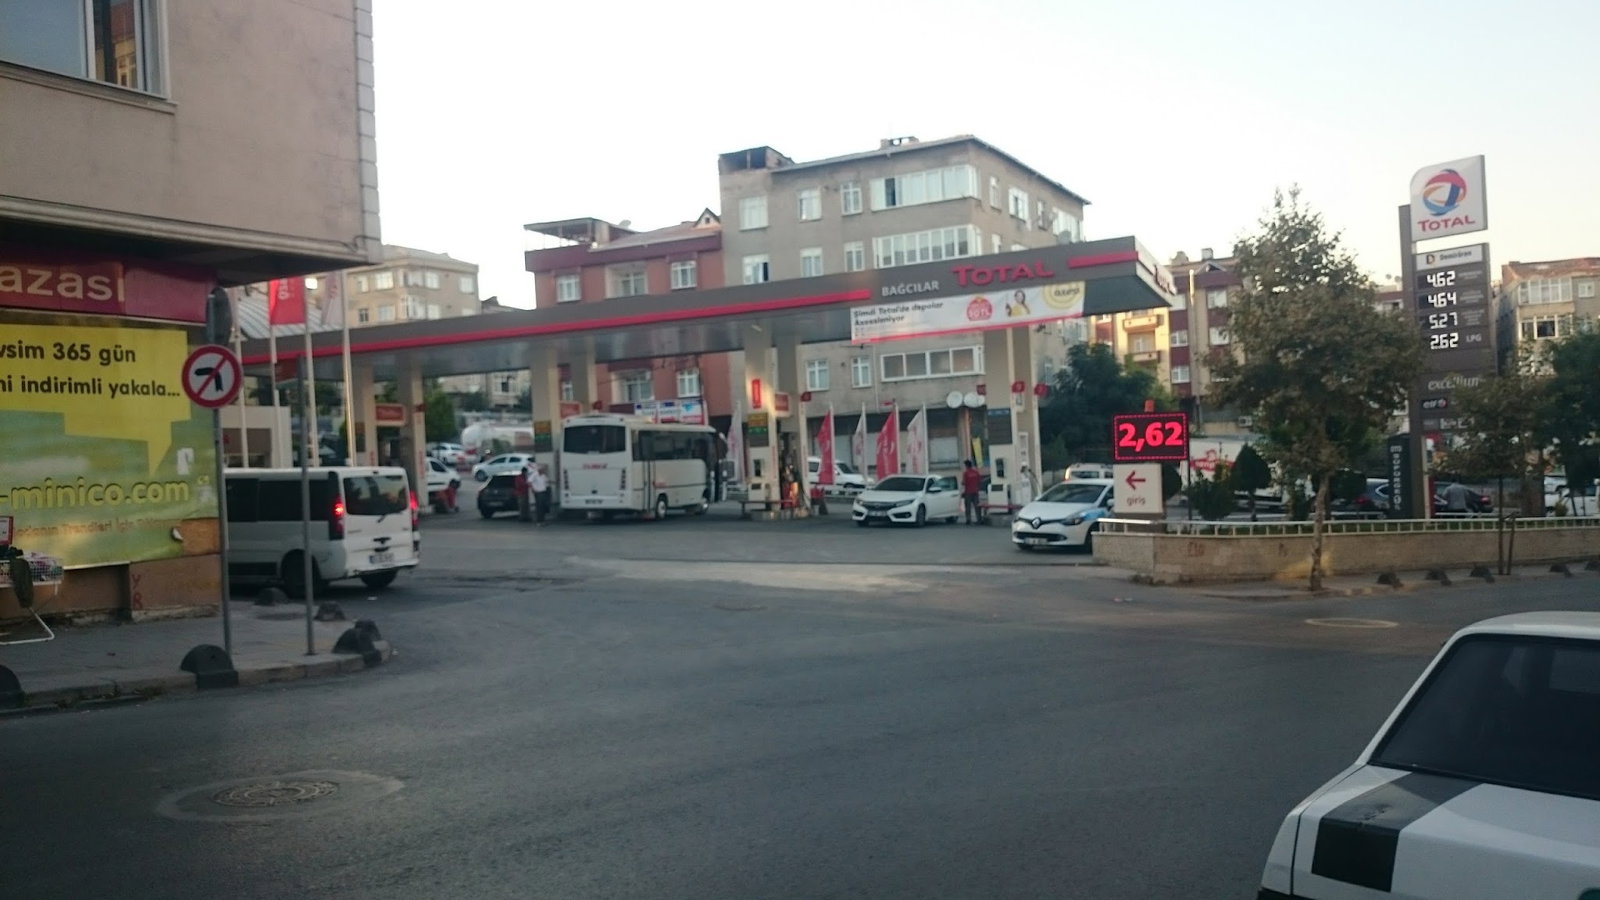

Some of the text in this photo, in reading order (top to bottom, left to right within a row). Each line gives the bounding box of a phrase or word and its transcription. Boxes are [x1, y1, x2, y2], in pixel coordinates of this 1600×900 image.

[1417, 215, 1476, 232] TOTAL
[881, 262, 1055, 297] BAĞCILAR TOTAL
[1465, 334, 1482, 343] LPG
[53, 342, 91, 361] 365
[99, 344, 136, 366] gün
[21, 375, 102, 395] indirimli
[108, 379, 180, 399] yakala...
[1118, 421, 1184, 452] 2,62
